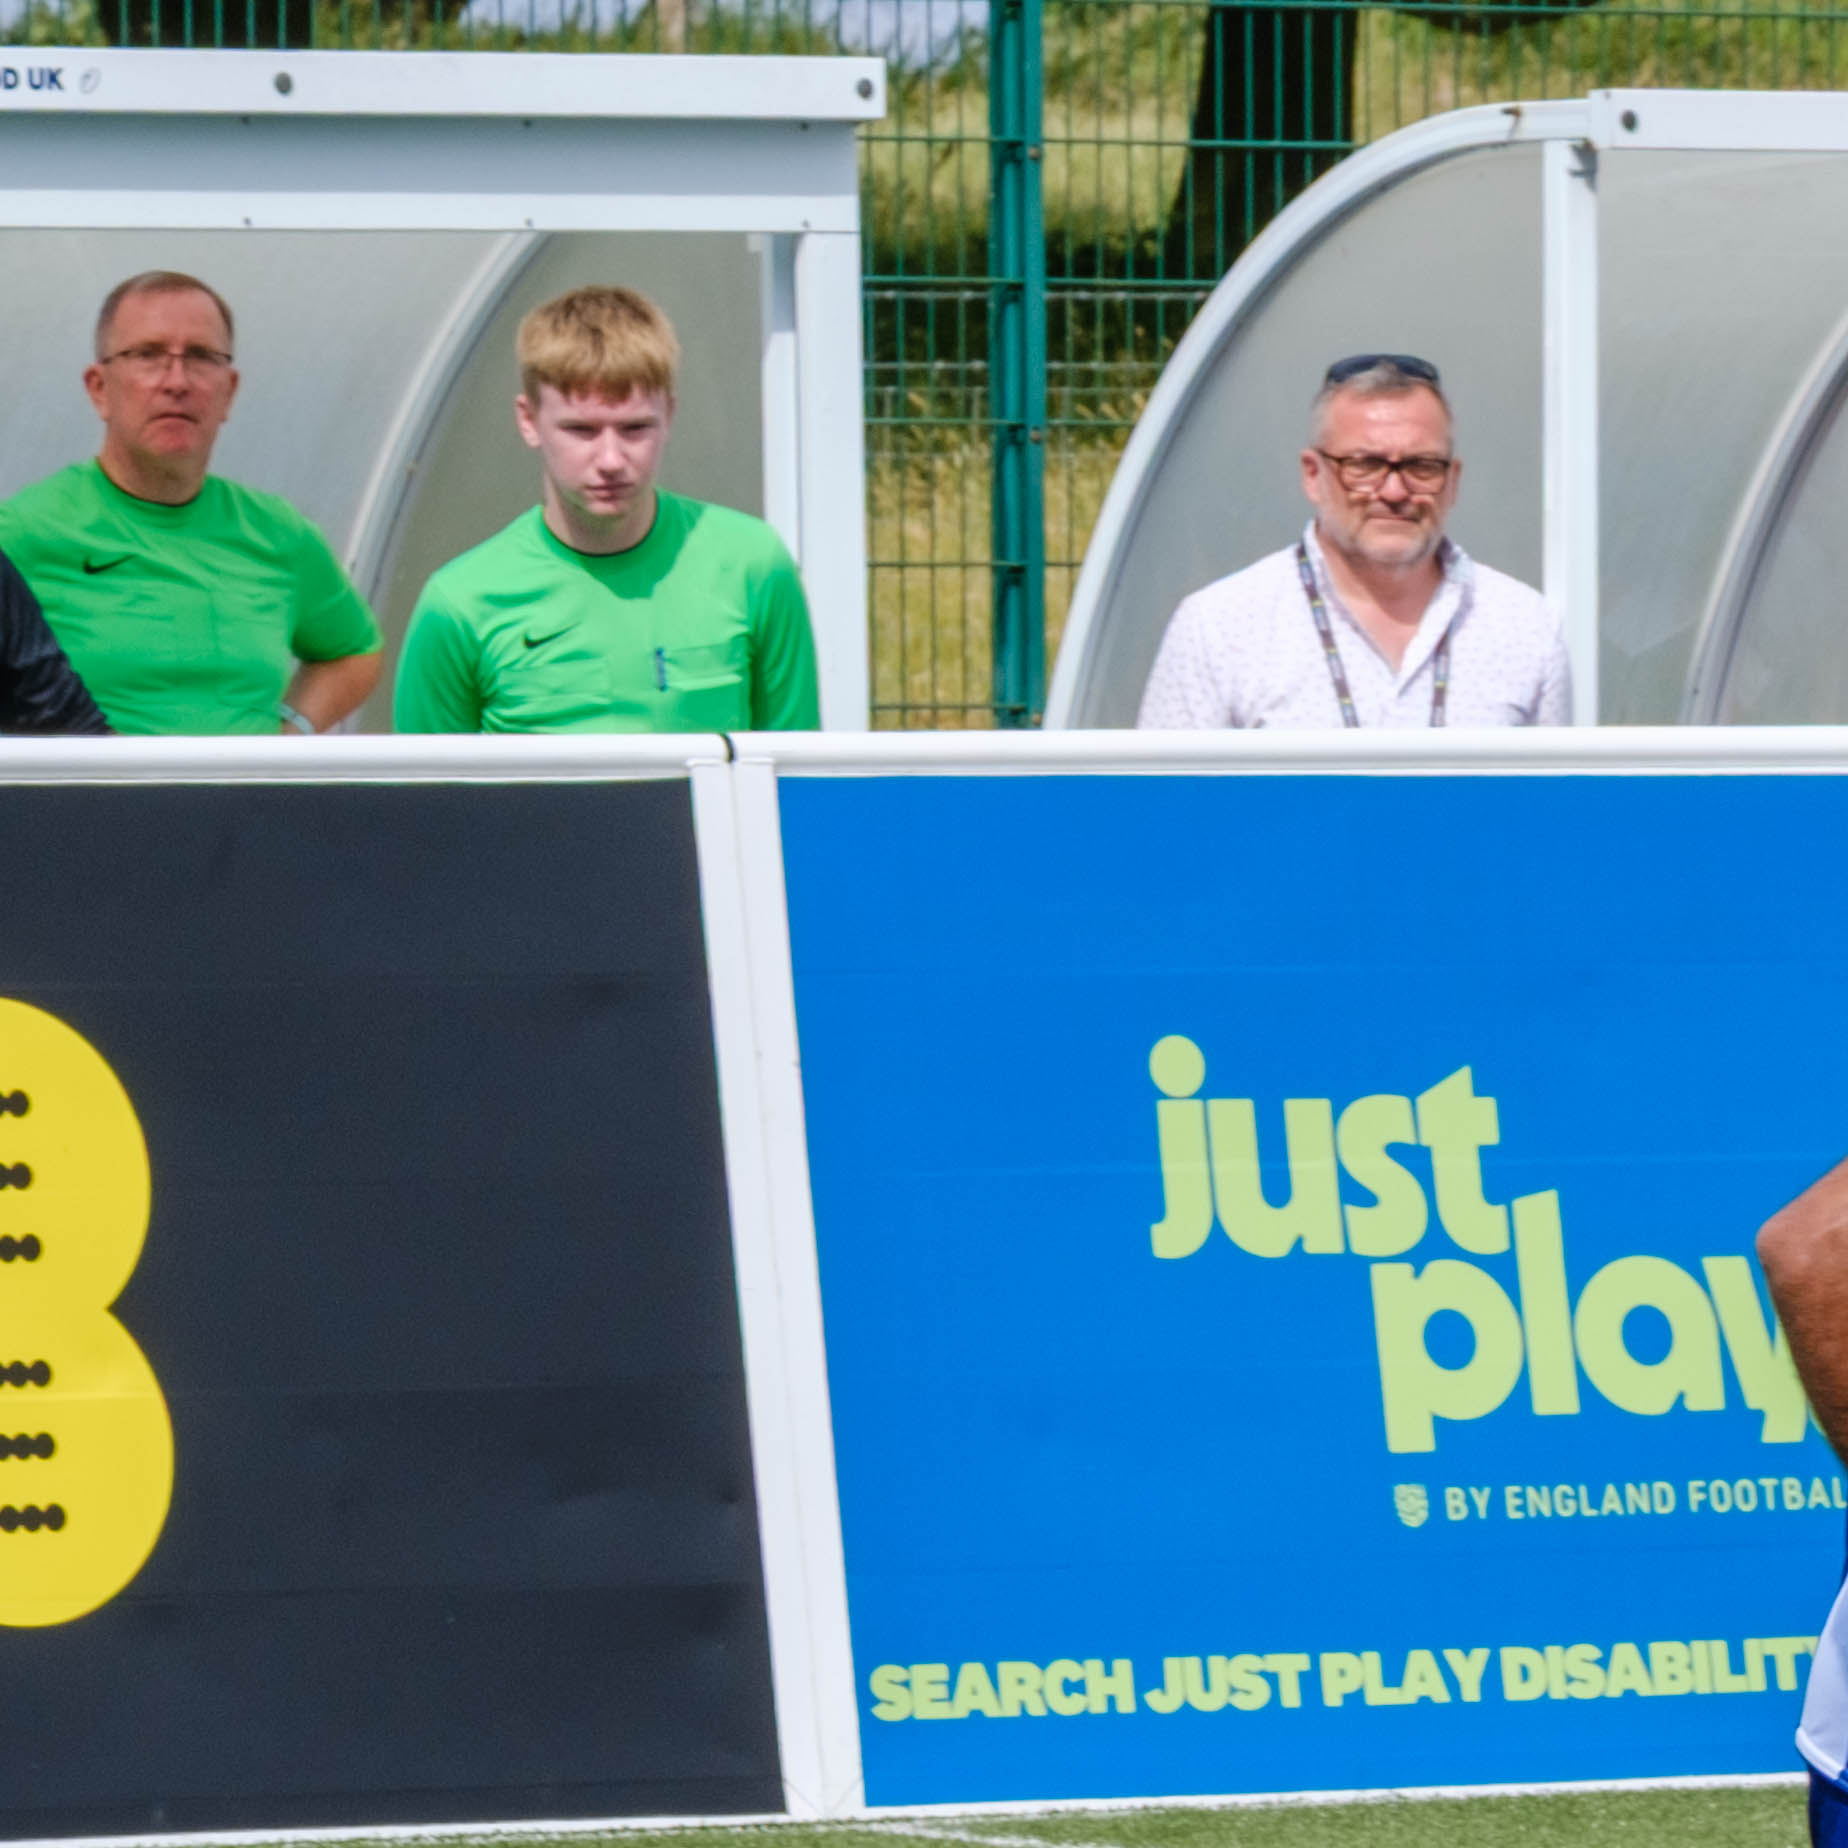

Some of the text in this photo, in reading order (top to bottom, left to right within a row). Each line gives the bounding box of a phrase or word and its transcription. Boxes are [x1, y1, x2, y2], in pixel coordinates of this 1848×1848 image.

[27, 66, 64, 91] UK
[1149, 1034, 1510, 1259] just
[1445, 1476, 1847, 1521] BY ENGLAND FOOTBAL
[870, 1636, 1820, 1722] SEARCH JUST PLAY DISABILIT
